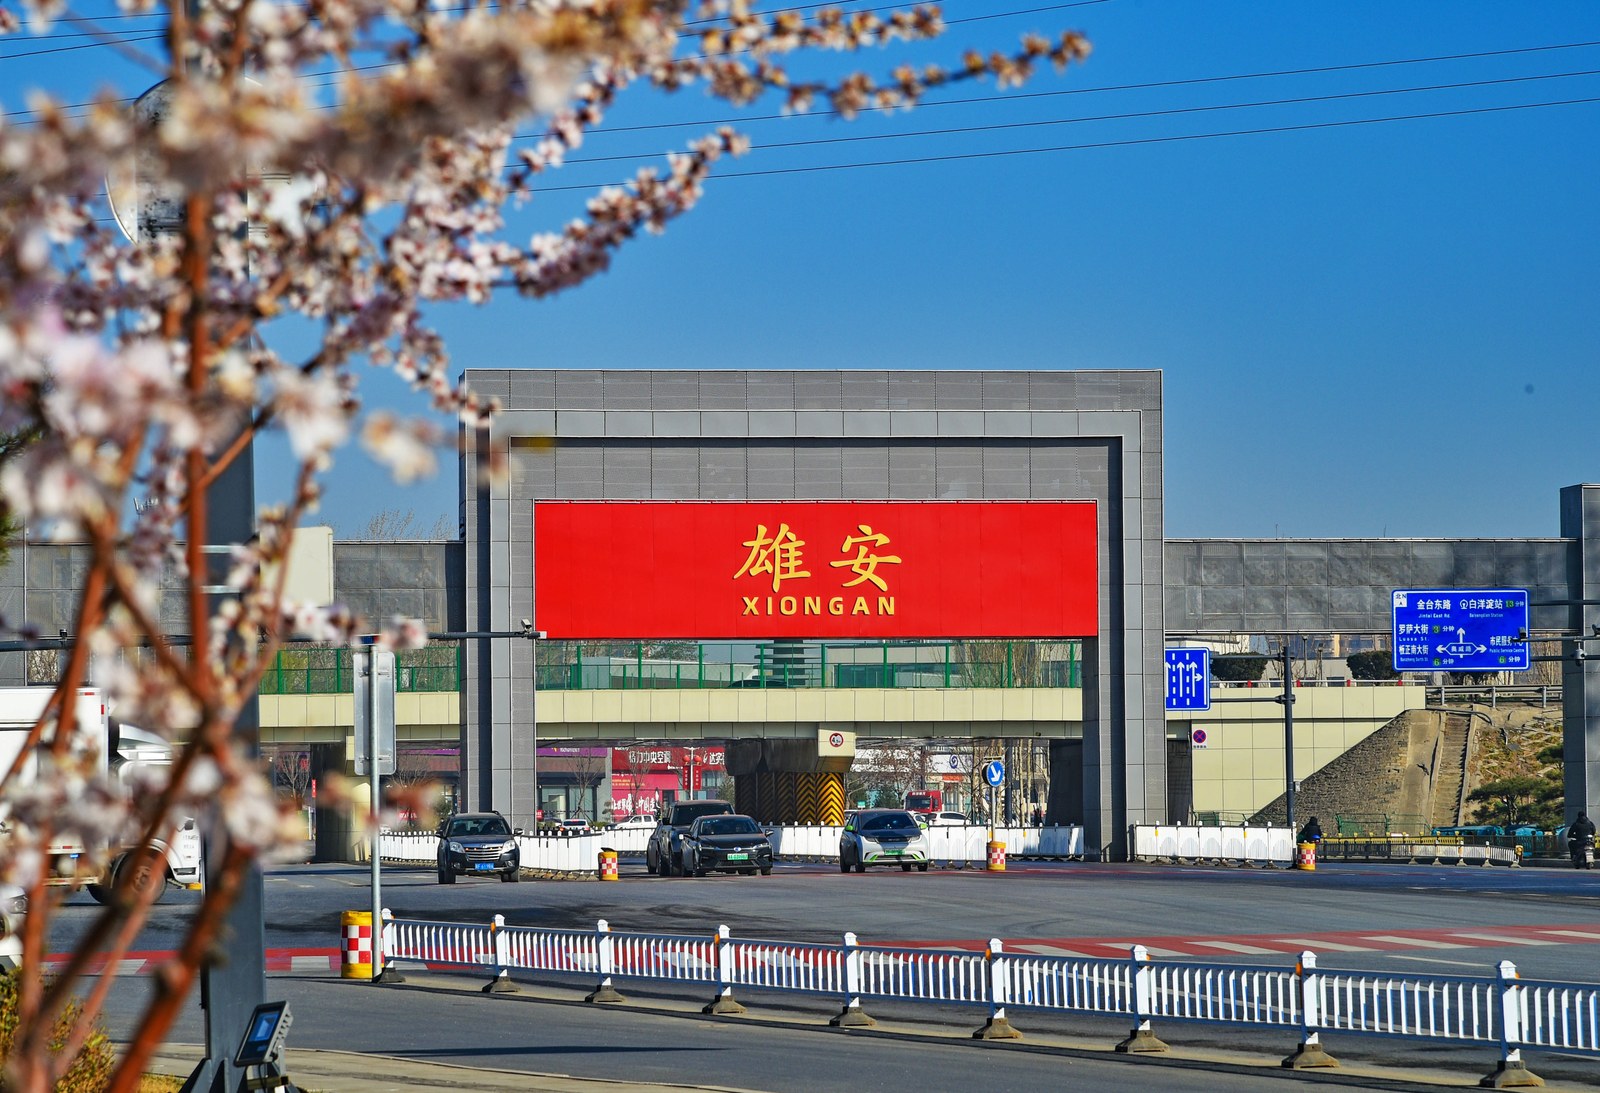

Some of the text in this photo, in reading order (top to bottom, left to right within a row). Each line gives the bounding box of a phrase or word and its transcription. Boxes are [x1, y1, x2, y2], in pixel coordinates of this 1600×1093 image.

[733, 523, 902, 593] 雄安
[742, 596, 895, 616] XIONGAN
[1416, 599, 1451, 610] 金台东路
[1469, 599, 1503, 610] 白洋淀站
[1505, 600, 1514, 608] 13
[1399, 624, 1428, 635] 罗萨大街
[1499, 656, 1505, 664] 6
[629, 750, 671, 764] 格力中央空调
[709, 752, 725, 765] 达实
